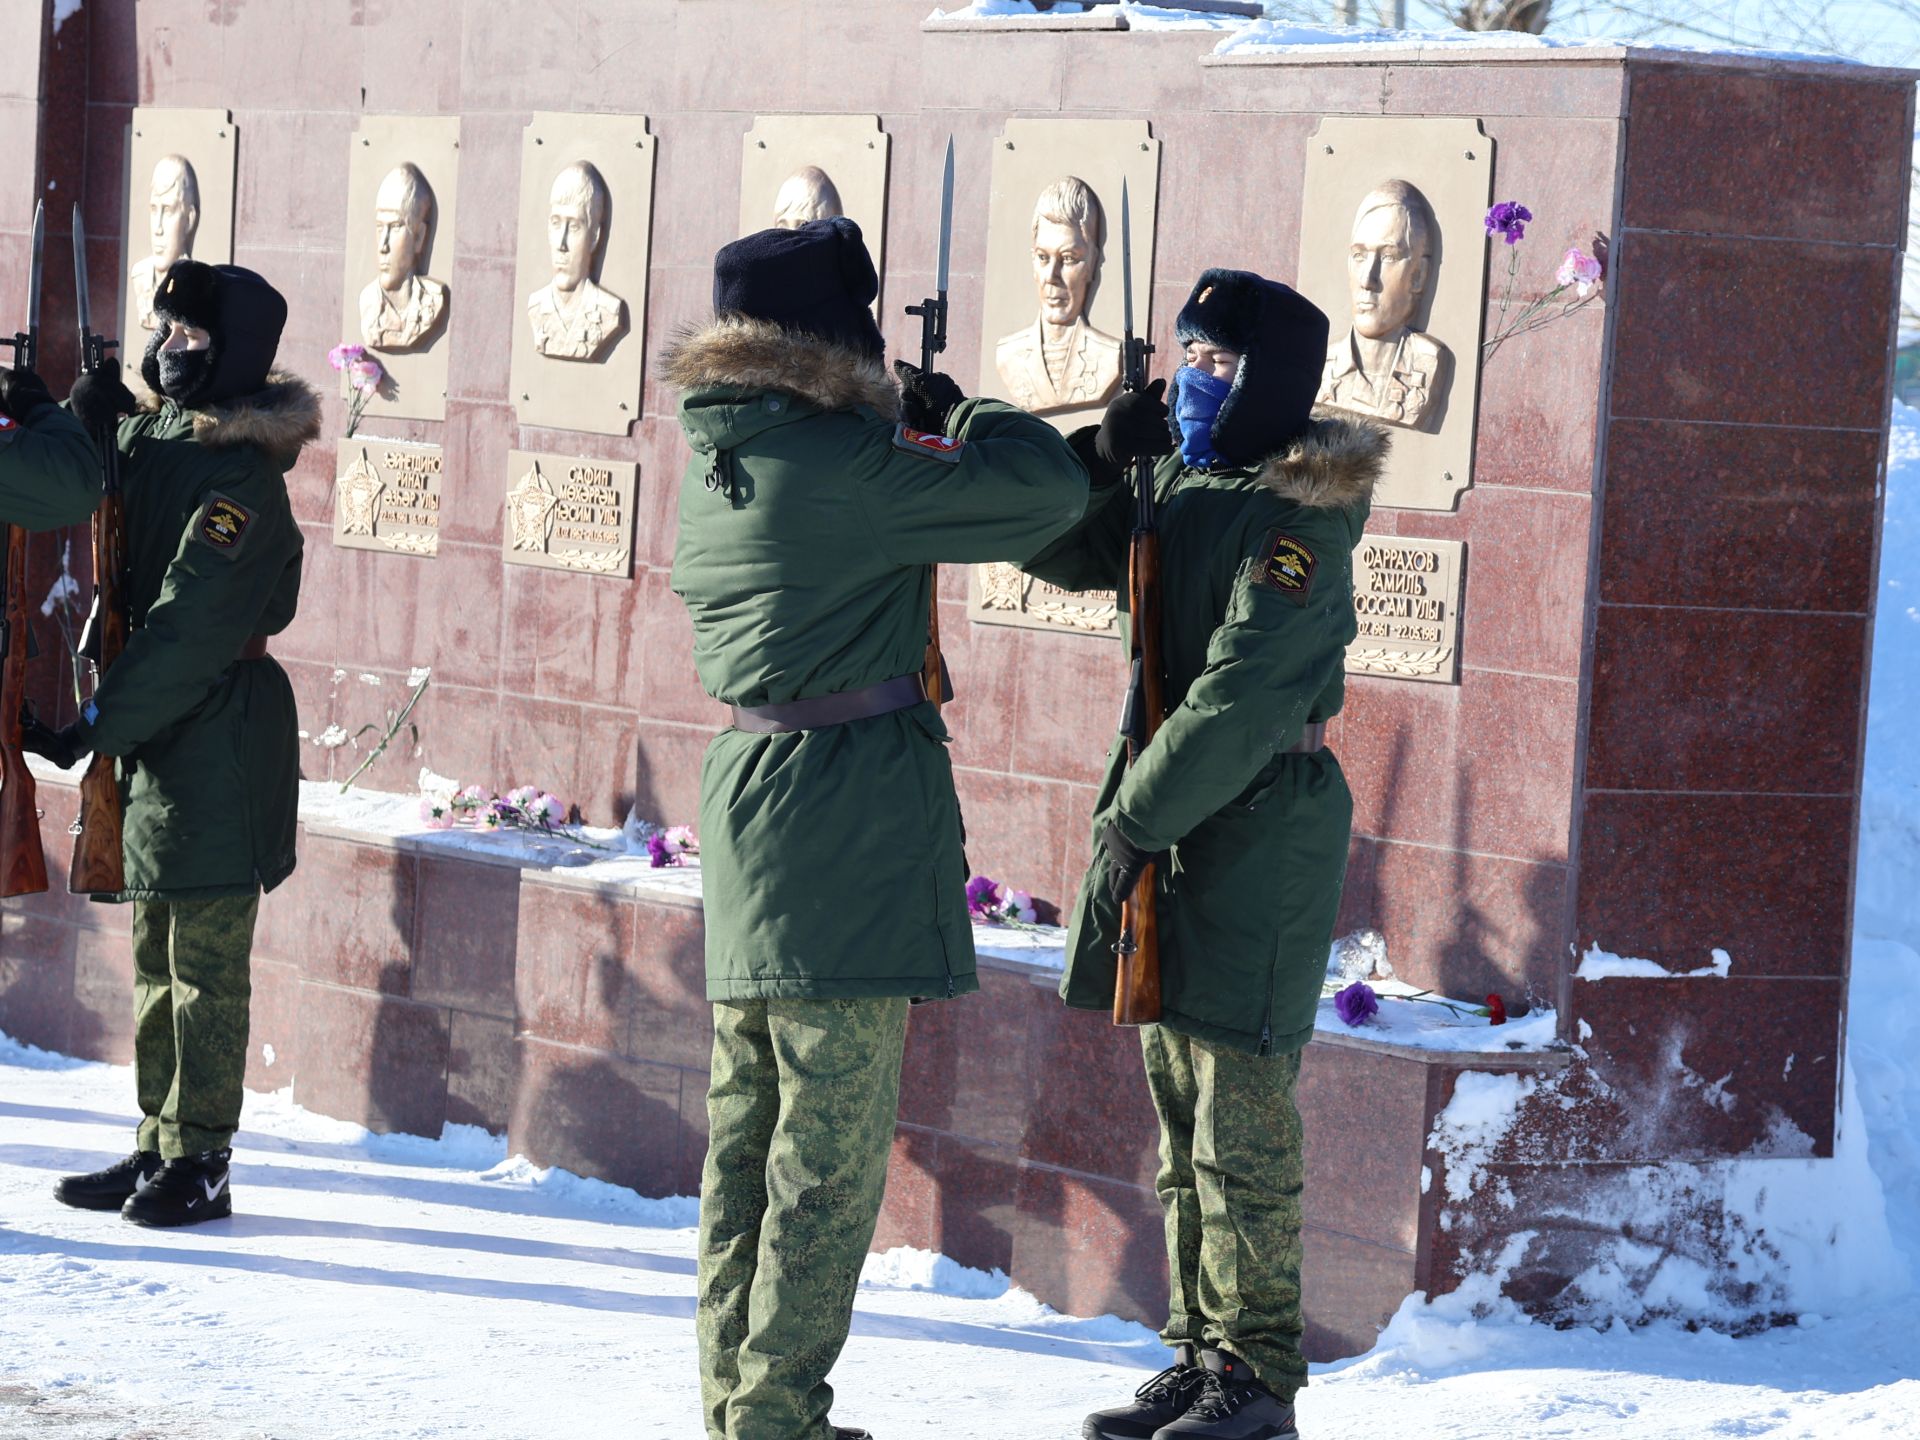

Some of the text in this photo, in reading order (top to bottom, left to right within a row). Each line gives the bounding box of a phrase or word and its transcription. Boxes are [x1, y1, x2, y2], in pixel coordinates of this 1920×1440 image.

[397, 471, 424, 490] РИНАТ
[568, 466, 609, 485] САФИН
[420, 492, 440, 511] УЛЫ
[560, 484, 616, 506] МӨХӘРРӘМ
[554, 502, 619, 525] НӘСИМ УЛЫ
[1363, 546, 1435, 571] ФАРРАХОВ
[1369, 571, 1423, 594] РАМИЛЬ
[1353, 593, 1440, 620] ОССАМ УЛЫ
